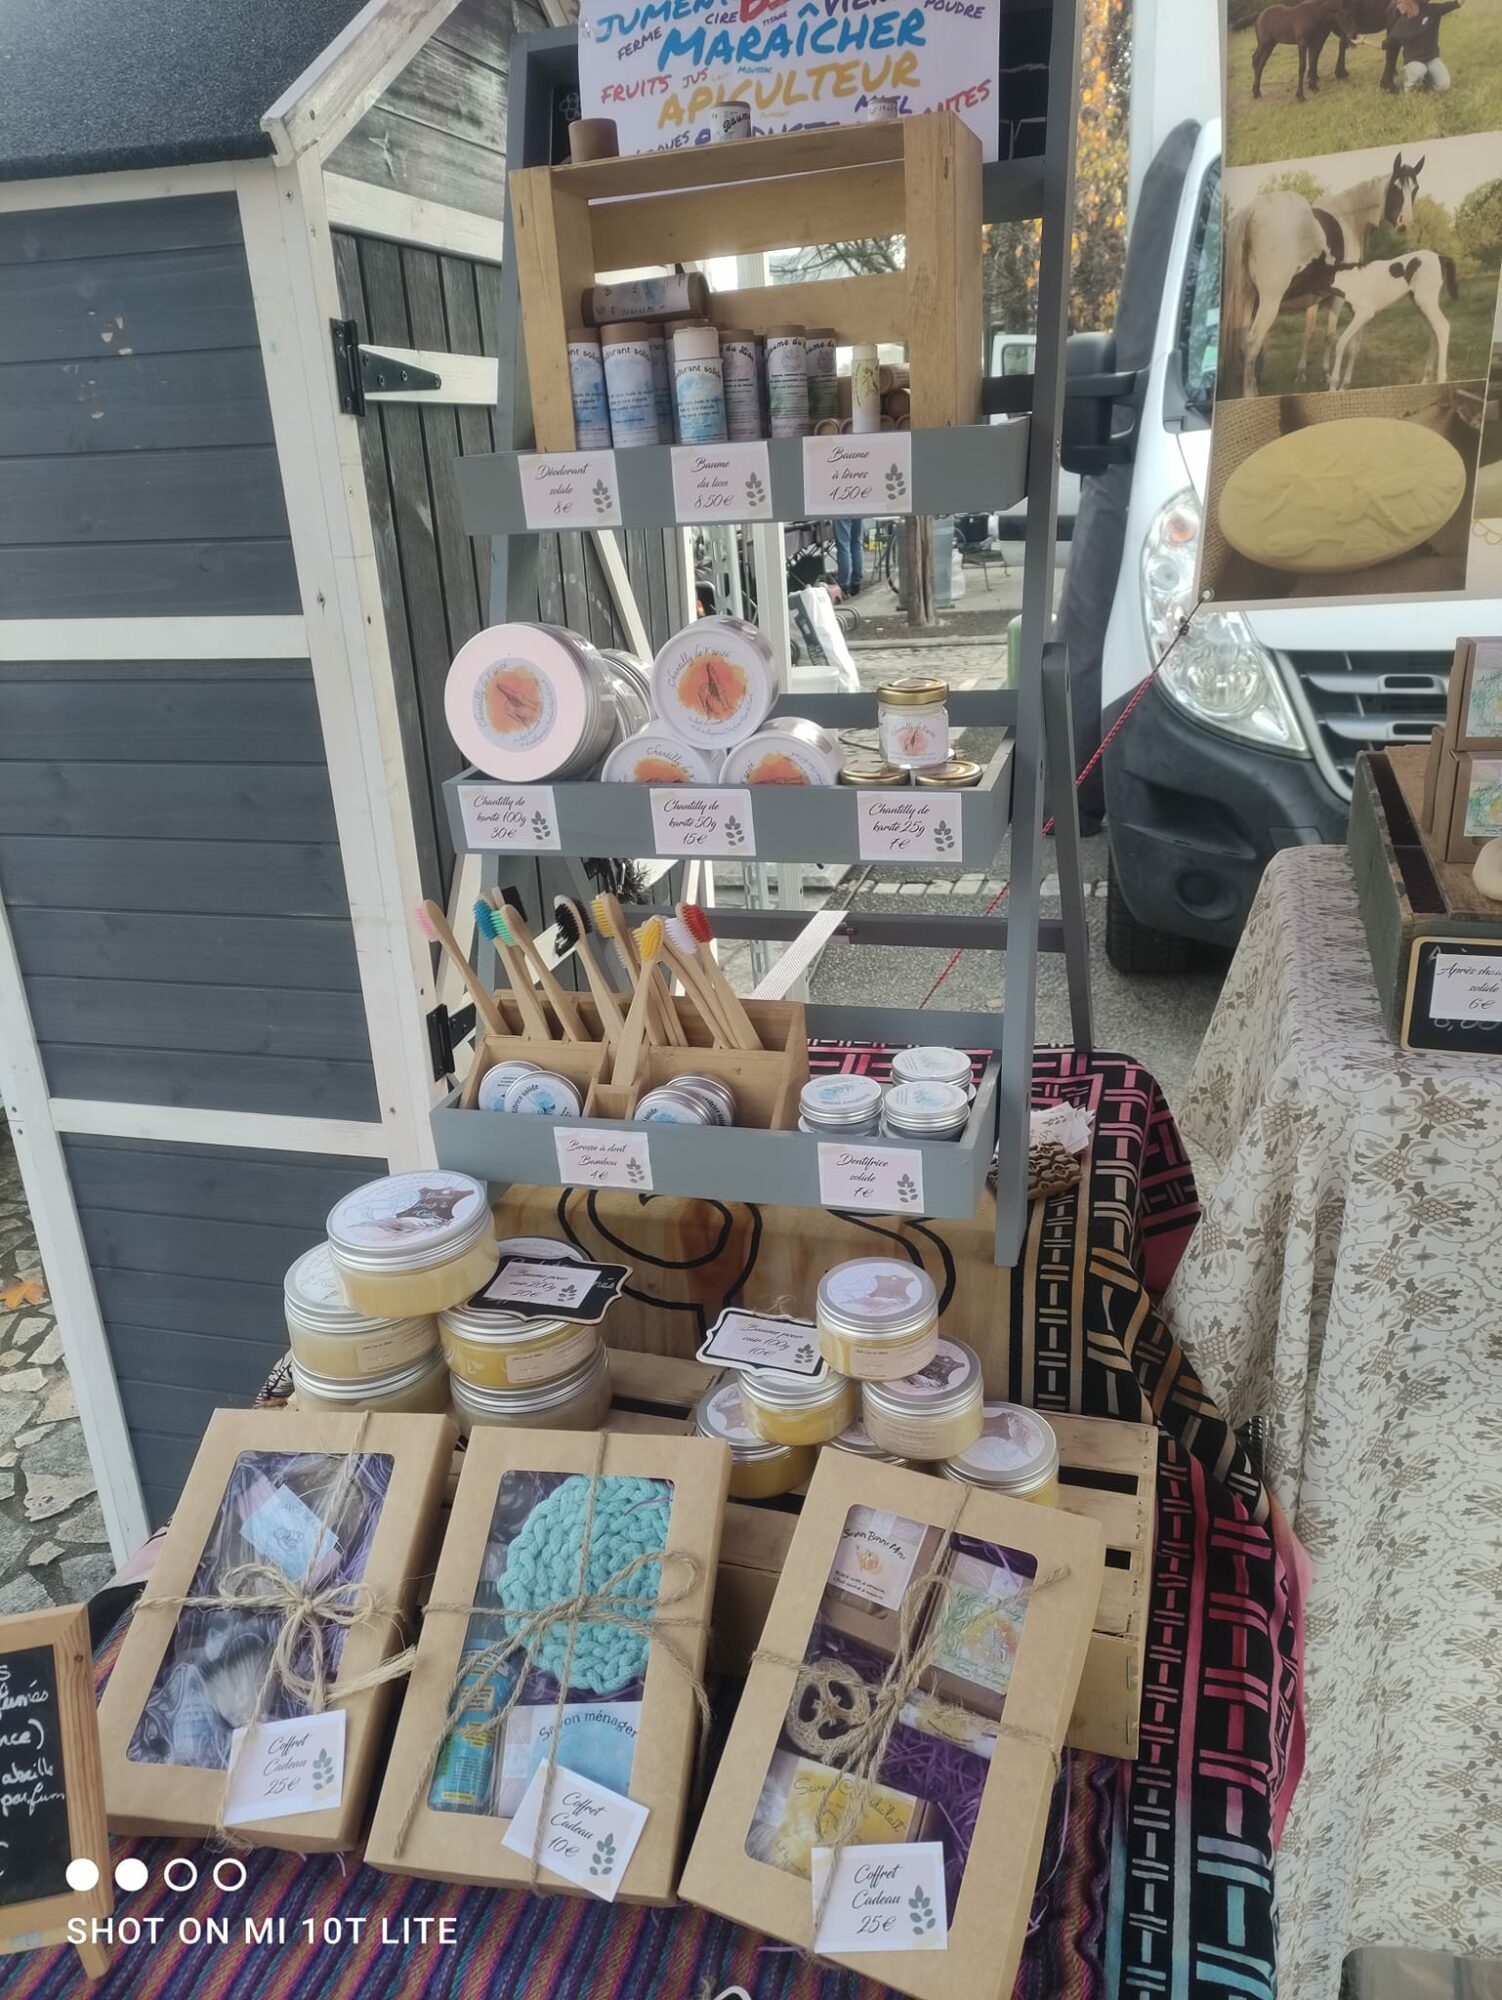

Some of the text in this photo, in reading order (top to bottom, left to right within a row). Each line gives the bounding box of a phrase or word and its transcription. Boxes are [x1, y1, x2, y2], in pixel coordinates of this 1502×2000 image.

[704, 11, 739, 25] CIRE
[924, 0, 986, 19] POUDRE
[617, 26, 663, 61] FERME
[656, 3, 927, 72] MARAÎCHER
[682, 67, 709, 89] JUS
[600, 74, 673, 104] FRUITS
[656, 50, 922, 130] APICULTEUR
[827, 447, 869, 462] Baume
[535, 463, 589, 481] Déodorant
[691, 457, 730, 473] Baume
[841, 468, 868, 480] lèvres
[549, 483, 574, 496] solide
[697, 477, 709, 489] du
[553, 501, 574, 515] 8€
[473, 795, 526, 811] Chantilly de
[663, 799, 720, 815] Chantilly de
[868, 803, 930, 820] Chantilly de
[476, 811, 527, 828] karité 100g
[668, 816, 717, 833] karité 50g
[872, 821, 926, 838] karité 25g
[682, 833, 708, 845] 15€
[1436, 962, 1477, 979] Après
[1468, 982, 1500, 994] solide
[1468, 997, 1496, 1010] 6€
[566, 1140, 597, 1152] Brosse
[607, 1143, 628, 1153] dent
[578, 1155, 618, 1167] Bambou
[836, 1153, 889, 1171] Dentifrice
[849, 1171, 877, 1183] solide
[740, 1323, 780, 1337] Baume
[762, 1338, 791, 1352] 100g
[539, 1709, 639, 1742] Saon ménager
[268, 1733, 310, 1757] Coffret
[2, 1757, 54, 1785] abeille
[263, 1757, 308, 1776] Cadeau
[263, 1777, 302, 1796] 25€
[562, 1792, 608, 1817] Coffret
[550, 1812, 595, 1841] Cadeau
[548, 1836, 580, 1858] 10€
[854, 1863, 905, 1888] Coffret
[852, 1890, 902, 1909] Cadeau
[856, 1914, 896, 1935] 25€
